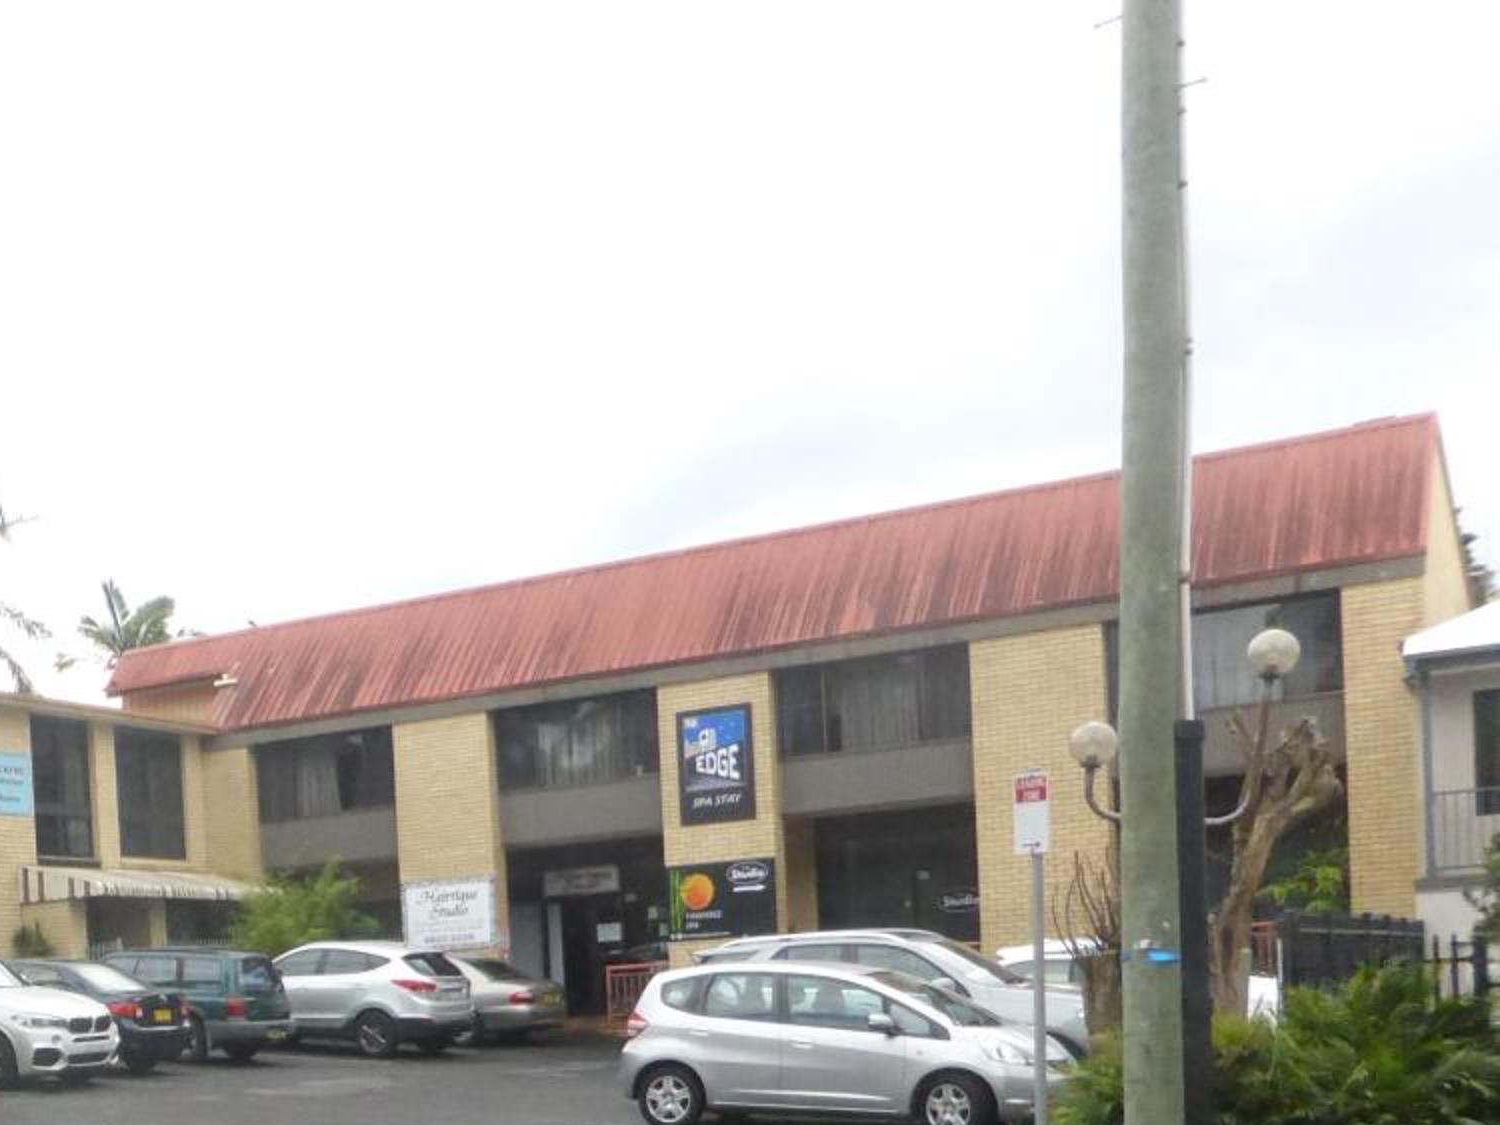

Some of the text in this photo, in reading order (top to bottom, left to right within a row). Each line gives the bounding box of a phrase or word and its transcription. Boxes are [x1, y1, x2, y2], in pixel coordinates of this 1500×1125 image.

[695, 744, 741, 780] EDGE
[692, 792, 742, 810] SPA STAY
